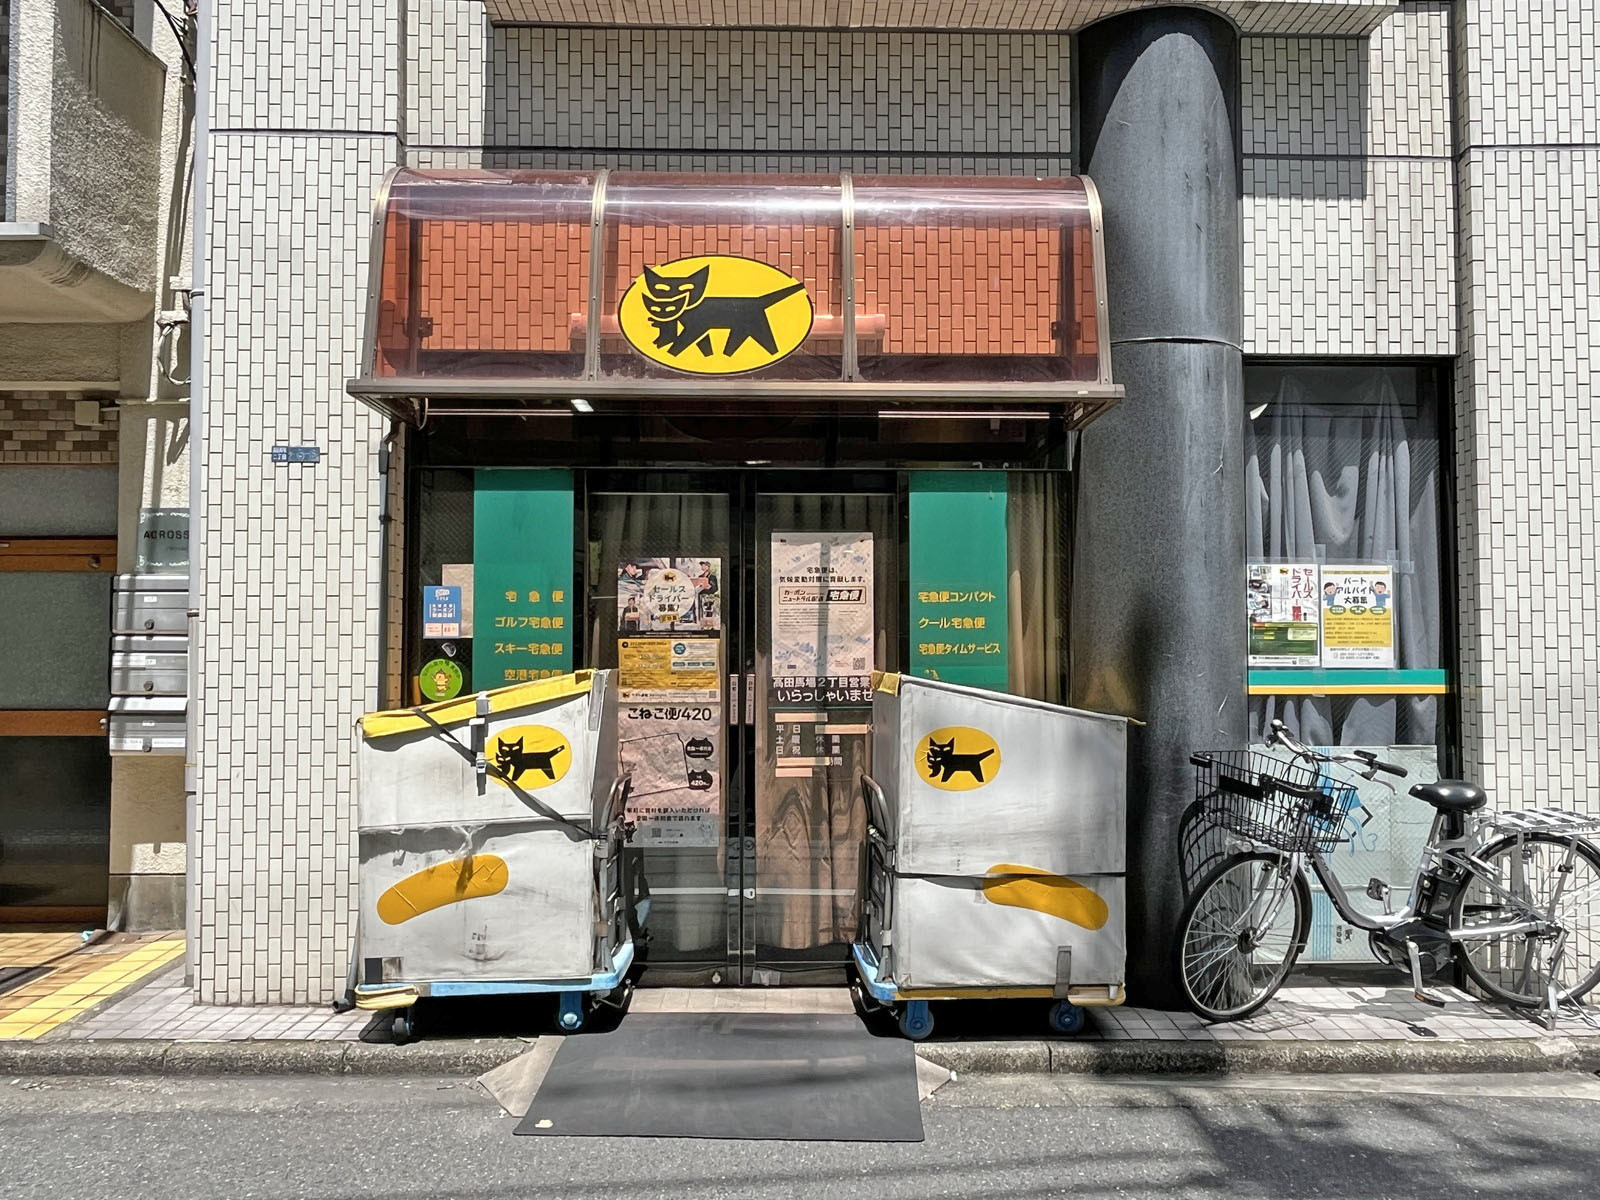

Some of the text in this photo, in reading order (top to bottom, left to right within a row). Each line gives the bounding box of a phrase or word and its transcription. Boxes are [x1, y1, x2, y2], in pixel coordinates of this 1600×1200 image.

[143, 530, 189, 540] ACROSS
[652, 585, 686, 593] セールス
[505, 590, 564, 603] 宅急便
[648, 594, 690, 603] ドライバー
[830, 590, 860, 601] 宅急便
[918, 591, 996, 603] 宅急便コンパクト
[495, 616, 564, 629] ゴルフ宅急便
[919, 617, 985, 629] クール宅急便
[495, 643, 563, 655] スキー宅急便
[919, 643, 1001, 655] 宅急便タイムサービス
[777, 689, 873, 702] いらっしゃいませ
[628, 707, 712, 721] こねこ便420
